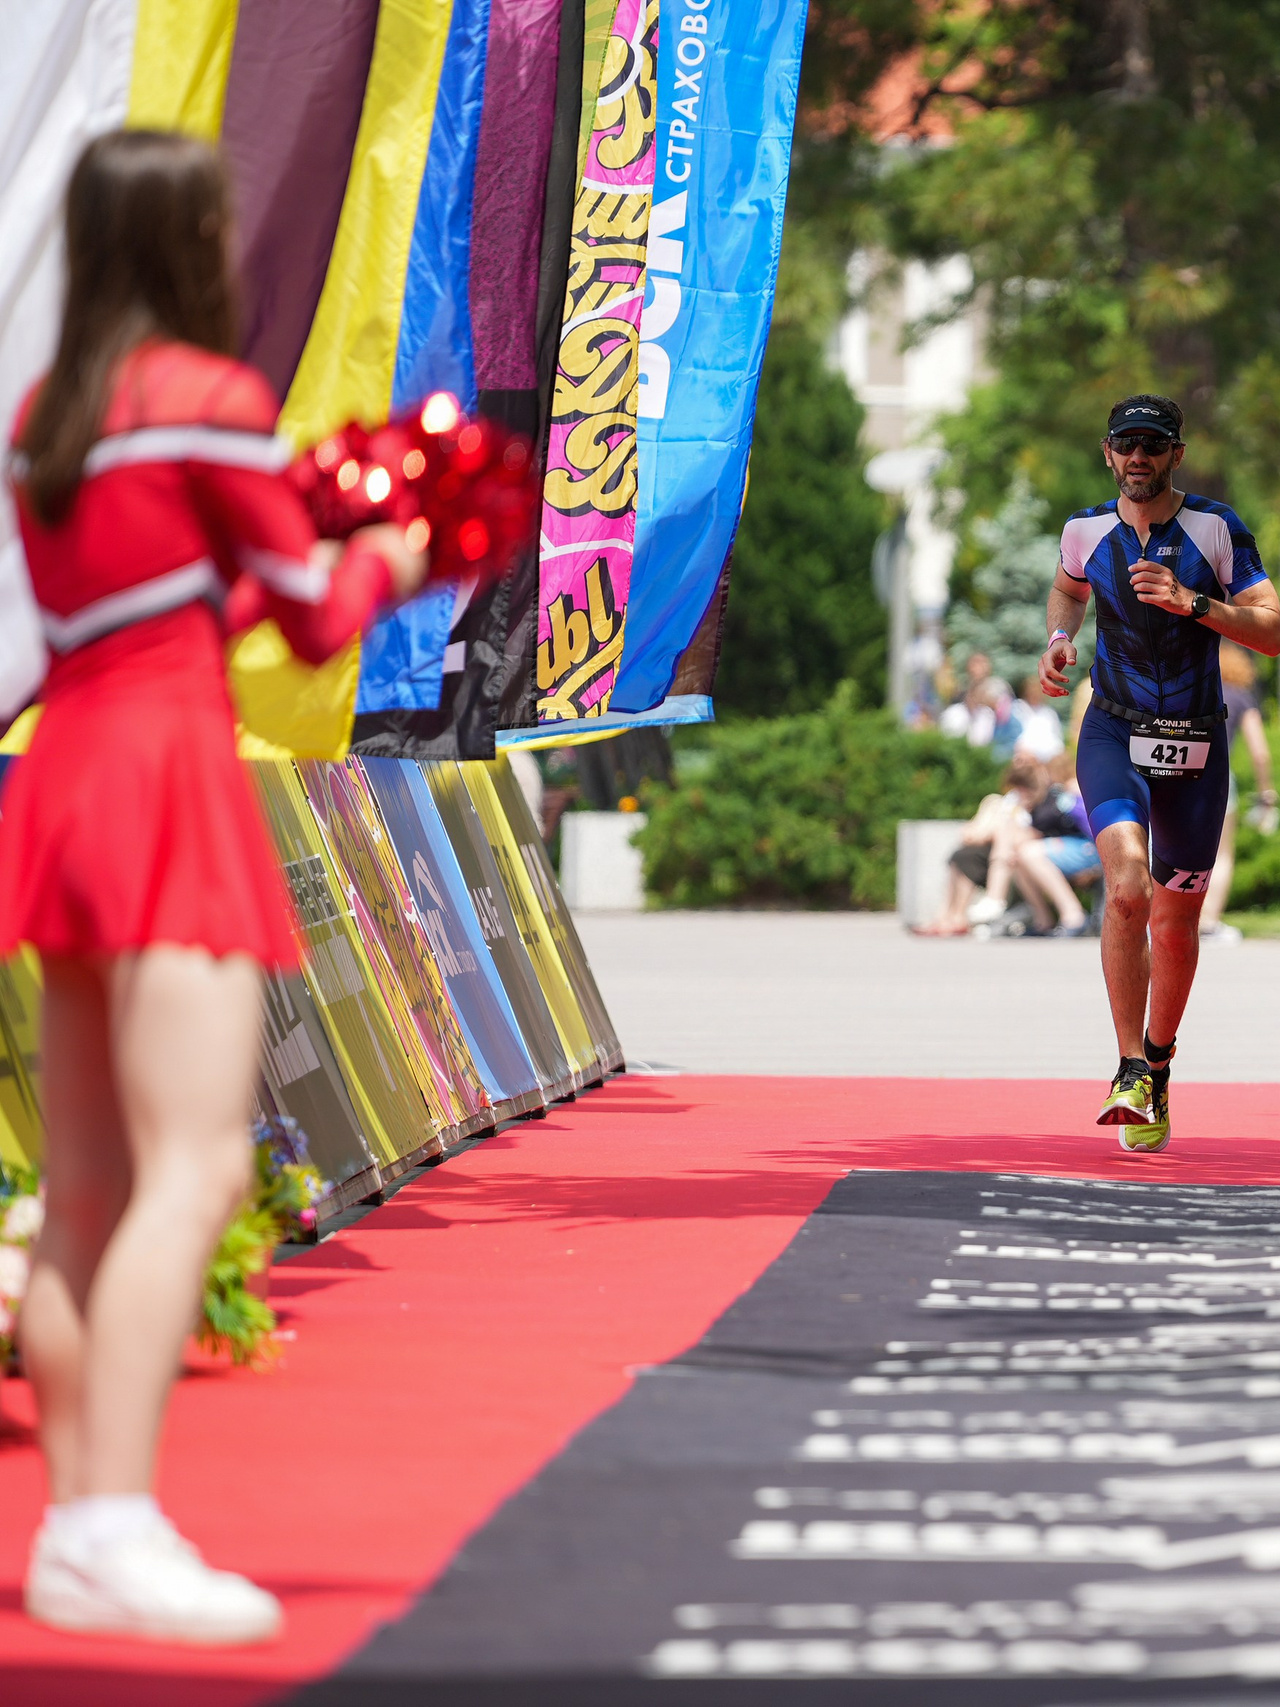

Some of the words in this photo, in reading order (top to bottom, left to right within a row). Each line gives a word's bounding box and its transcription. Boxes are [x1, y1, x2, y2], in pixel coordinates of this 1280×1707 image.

[1125, 407, 1160, 417] orca
[1150, 744, 1189, 765] 421
[1150, 768, 1184, 776] KONSTANTIN
